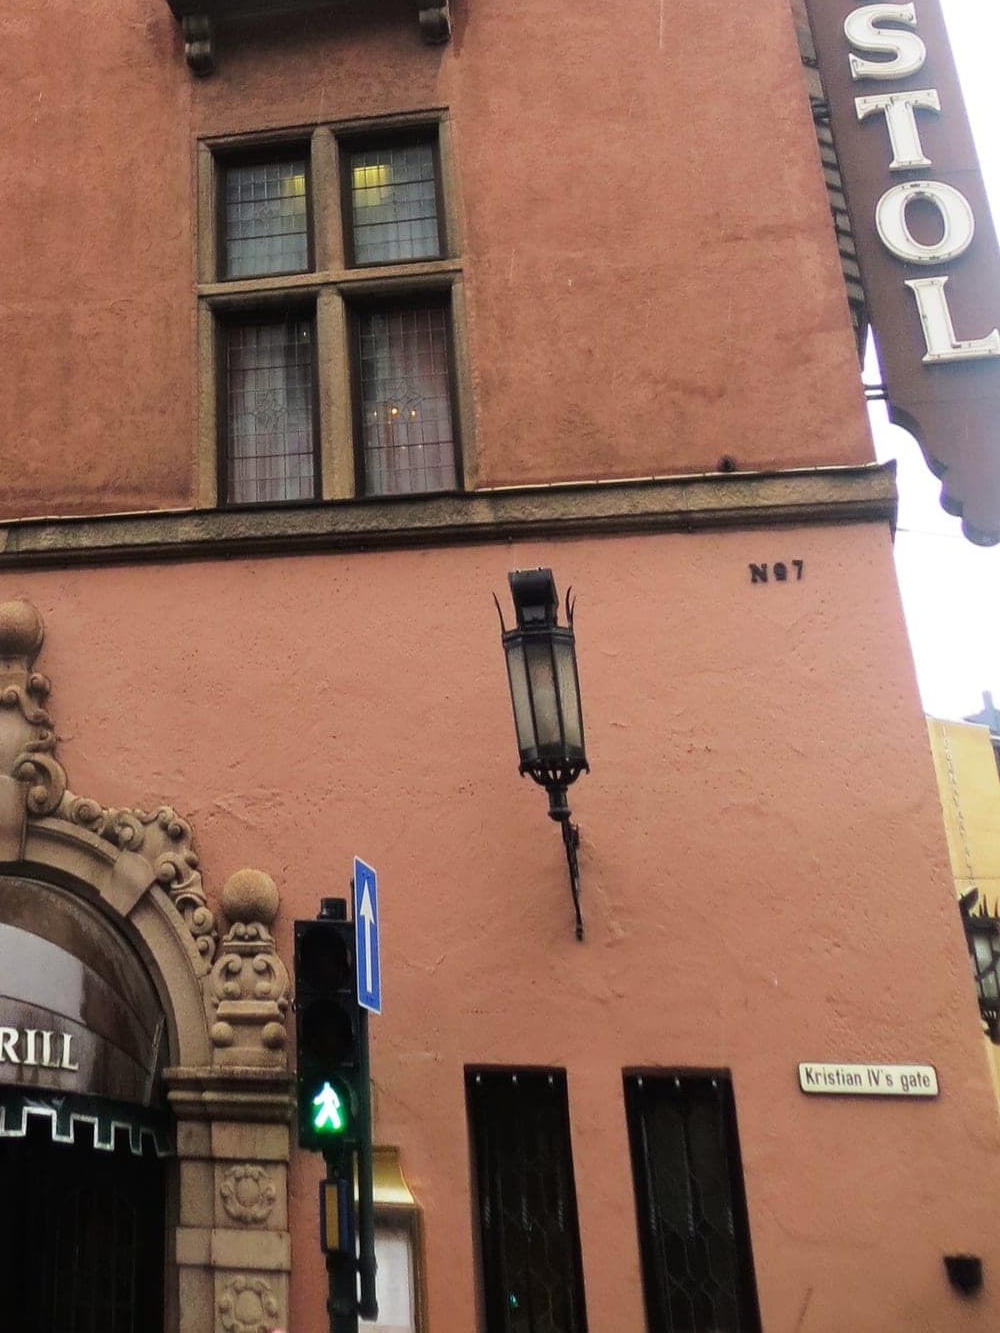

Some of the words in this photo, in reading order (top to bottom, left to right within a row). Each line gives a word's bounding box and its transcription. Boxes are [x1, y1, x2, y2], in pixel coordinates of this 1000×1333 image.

[804, 1066, 863, 1087] Kristian
[867, 1068, 894, 1088] IV's
[900, 1071, 931, 1093] gate
